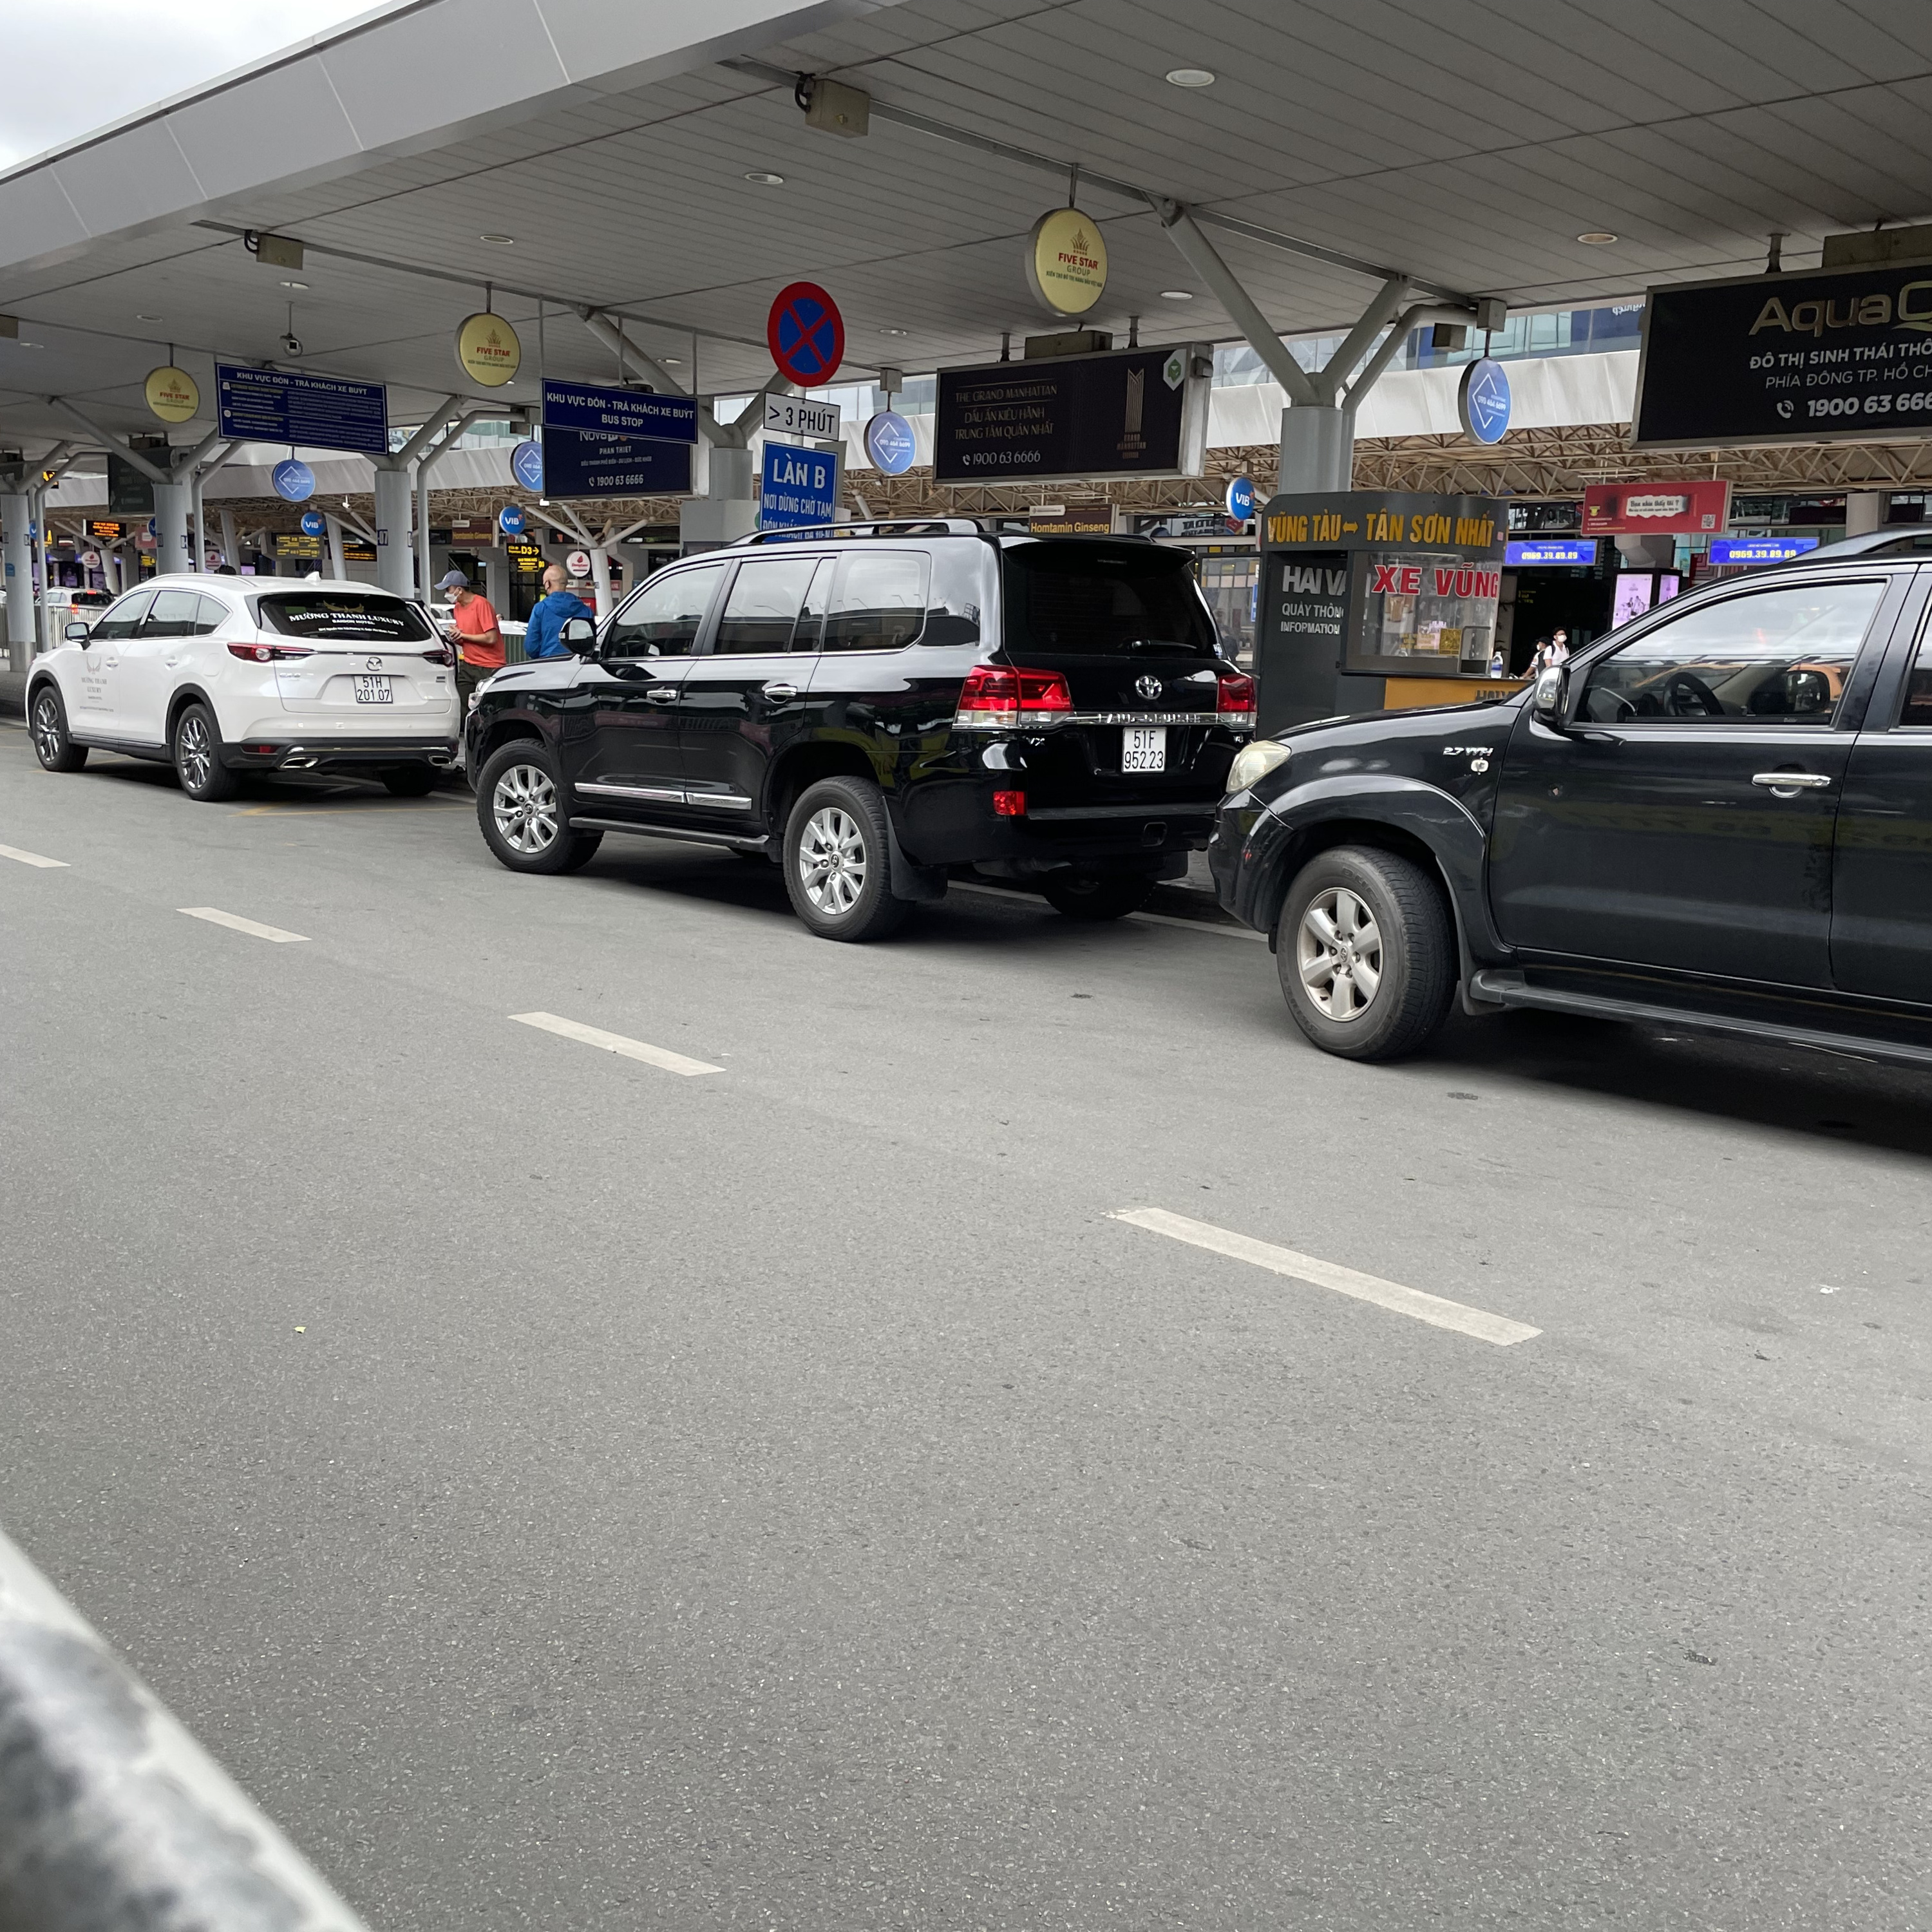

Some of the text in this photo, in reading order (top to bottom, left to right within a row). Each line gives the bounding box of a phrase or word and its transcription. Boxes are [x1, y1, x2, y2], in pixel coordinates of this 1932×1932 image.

[1058, 252, 1098, 270] FIVE STAR
[1067, 265, 1090, 276] GROUP
[477, 346, 492, 355] FIVE
[1750, 352, 1774, 369] ĐÔ
[1779, 352, 1804, 369] THỊ
[1809, 348, 1849, 364] SINH
[1853, 343, 1894, 361] THÁI
[237, 372, 253, 381] KHU
[337, 384, 348, 393] XE
[1766, 373, 1801, 389] PHÍA
[1806, 370, 1853, 386] ĐÔNG
[1857, 369, 1878, 383] TP.
[1884, 362, 1908, 381] HỒ
[956, 385, 1057, 402] THE GRAND MANHATTAN
[547, 392, 565, 403] KHU
[567, 395, 585, 406] VỰC
[631, 402, 659, 415] KHÁCH
[661, 407, 671, 417] XE
[673, 407, 694, 419] BUÝT
[1808, 397, 1859, 417] 1900
[1864, 394, 1892, 413] 63
[601, 414, 643, 428] BUS STOP
[785, 407, 793, 426] 3
[799, 408, 835, 433] PHÚT
[954, 428, 983, 440] TRUNG
[973, 450, 1041, 465] 1900 63 6666
[773, 453, 826, 489] LÀN B
[597, 474, 643, 487] 1900 63 6666
[764, 492, 832, 519] NƠI DỪNG CHỜ TẠM
[1236, 493, 1250, 506] VIB
[505, 517, 520, 526] VIB
[1030, 522, 1110, 534] Homtamin Ginseng
[1267, 507, 1495, 547] VŨNG TÀU TÂN SƠN NHẤT
[521, 545, 532, 555] D3
[1282, 565, 1323, 594] HAI
[1372, 562, 1499, 600] XE VŨNG
[1314, 602, 1344, 618] THÔN
[289, 612, 329, 622] MƯỜNG
[367, 614, 404, 627] LUXURY
[363, 676, 383, 689] 51H
[357, 689, 390, 701] 201.07
[1133, 730, 1157, 749] 51F
[1124, 750, 1164, 770] 952.23
